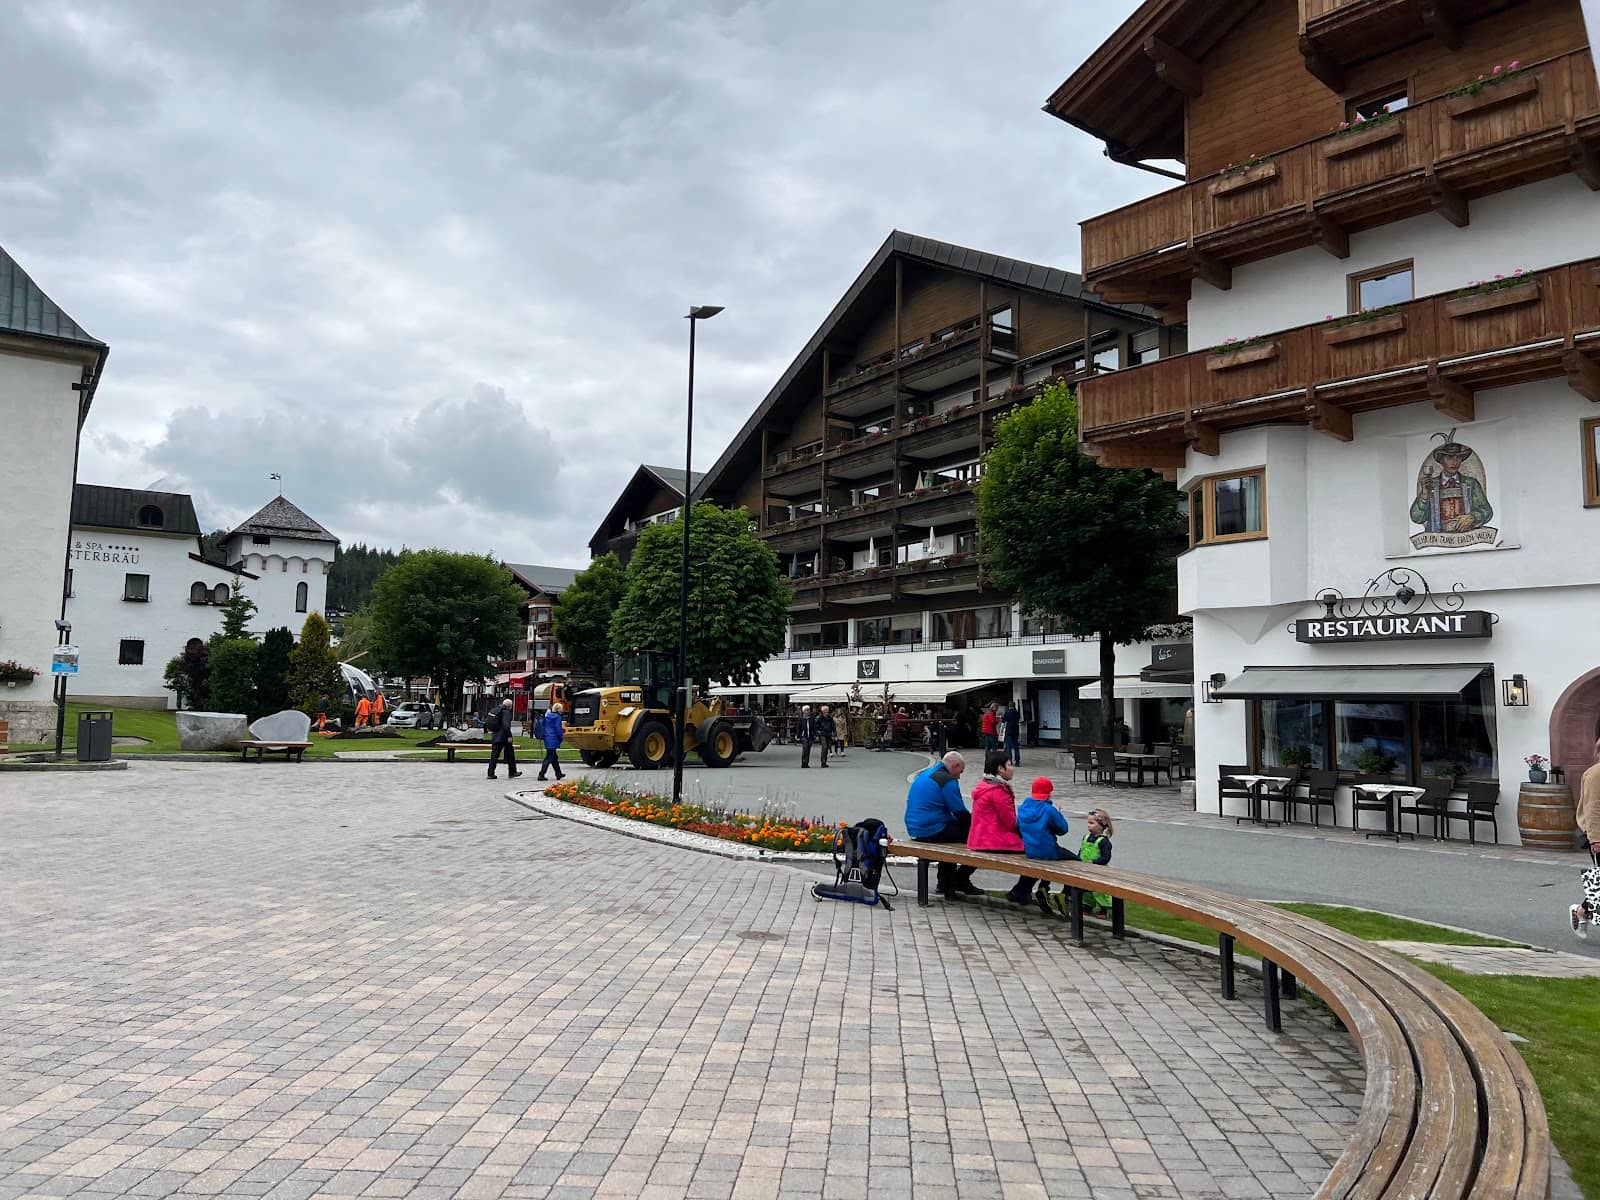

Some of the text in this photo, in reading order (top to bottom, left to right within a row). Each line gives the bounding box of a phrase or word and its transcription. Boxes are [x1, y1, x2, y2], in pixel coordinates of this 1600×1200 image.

[75, 541, 103, 550] & SPA
[1308, 615, 1466, 638] RESTAURANT
[631, 692, 641, 702] CAT
